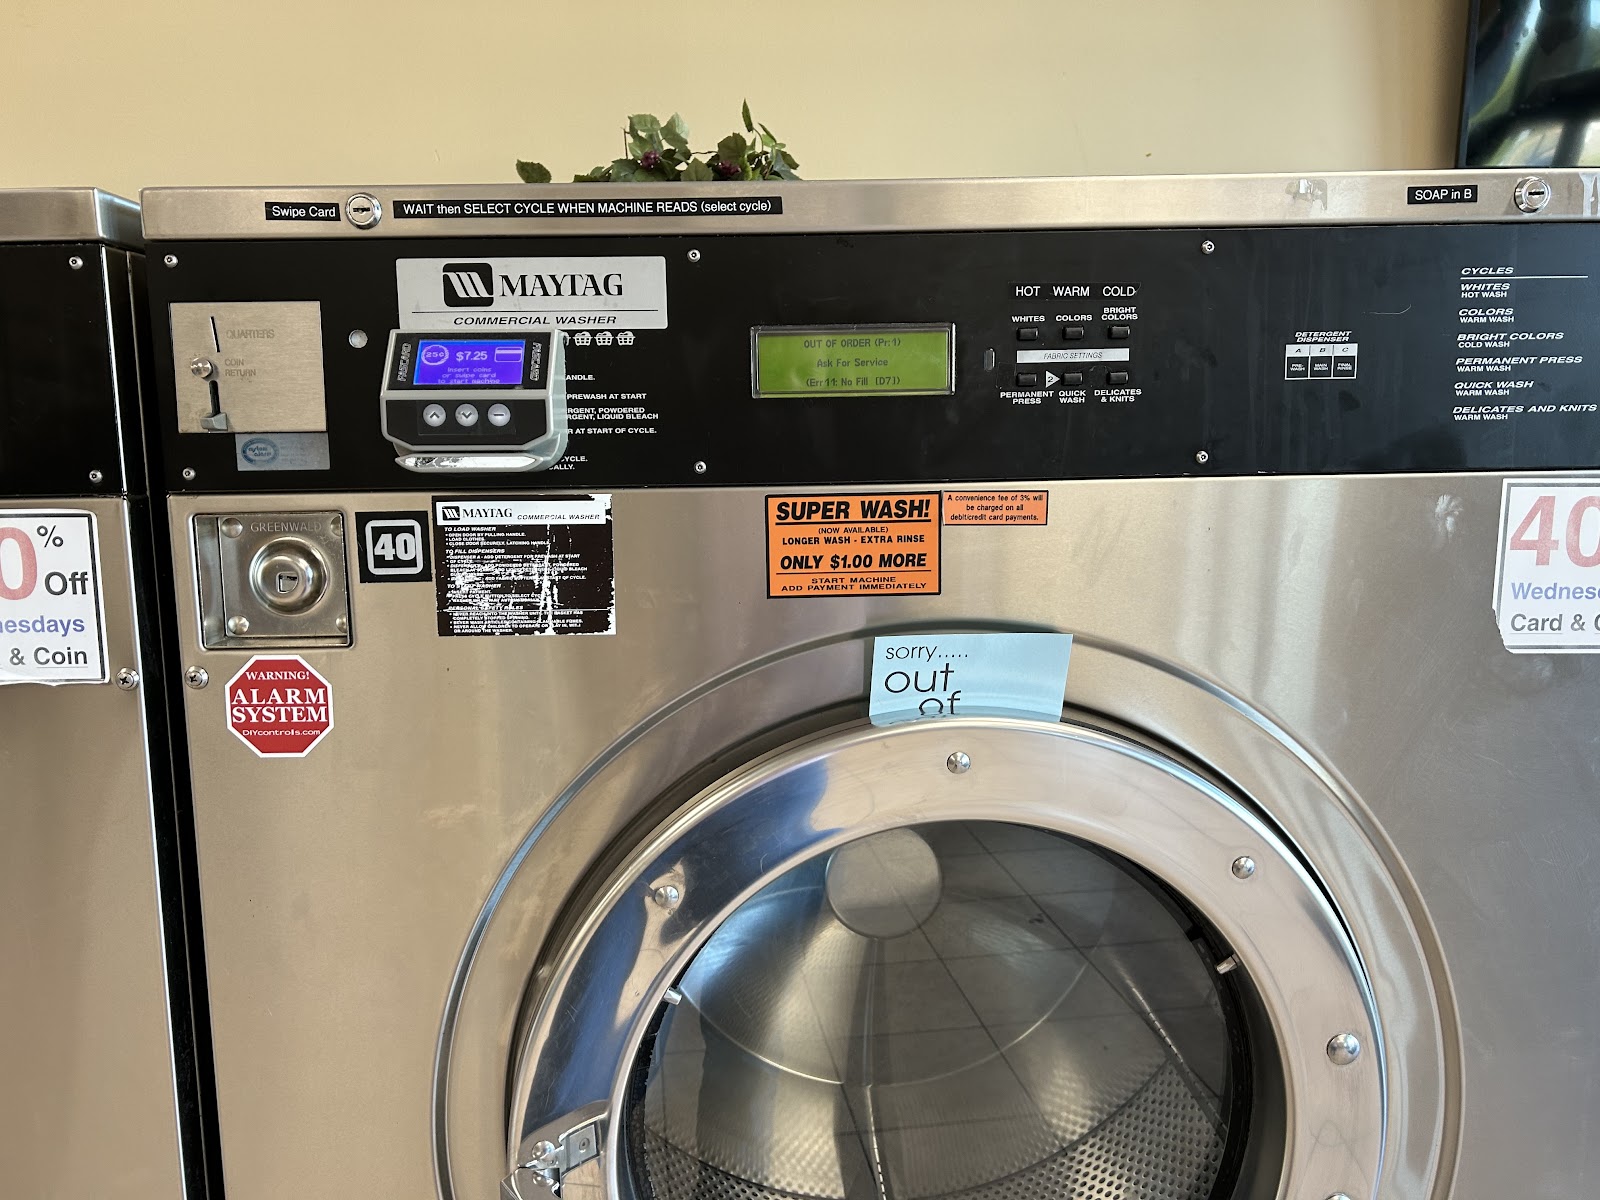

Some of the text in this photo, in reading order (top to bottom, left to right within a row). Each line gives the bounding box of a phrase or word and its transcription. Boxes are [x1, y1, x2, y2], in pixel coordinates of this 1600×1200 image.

[1414, 188, 1472, 200] SOAP in B
[403, 199, 771, 214] WAIT then SELECT CYCLE WHEN MACHINE READS (select cycle)
[272, 206, 336, 219] Swipe Card
[1461, 267, 1514, 275] CYCLES
[499, 273, 623, 298] MAYTAG
[1015, 285, 1135, 297] HOT WARM COLD
[1460, 283, 1510, 291] WHITES
[1458, 308, 1514, 316] COLORS
[453, 315, 617, 326] COMMERCIAL WASHER
[1055, 314, 1092, 322] COLORS
[226, 329, 275, 339] QUARTERS
[1457, 332, 1564, 341] BRIGHT COLORS
[804, 340, 822, 348] OUT
[826, 339, 837, 348] OF
[841, 339, 871, 347] ORDER
[1484, 340, 1510, 348] WASH
[456, 351, 488, 362] $7.25
[1455, 355, 1583, 365] PERMANENT PRESS
[817, 358, 889, 367] Ask For Service
[225, 369, 256, 377] RETURN
[841, 377, 852, 386] No
[856, 377, 868, 386] Fill
[1454, 380, 1534, 389] QUICK WASH
[1452, 404, 1597, 414] DELICATES AND KNITS
[462, 508, 512, 518] MAYTAG
[776, 499, 931, 521] SUPER WASH!
[977, 504, 1003, 512] charged
[1006, 513, 1039, 521] payments.
[251, 522, 322, 533] GREENWALD
[843, 526, 889, 534] AVAILABLE)
[1509, 496, 1600, 567] 40
[782, 534, 925, 545] LONGER WASH EXTRA RINSE
[374, 532, 416, 561] 40
[780, 553, 927, 570] ONLY $1.00 MORE
[44, 571, 88, 596] Off
[859, 582, 926, 590] IMMEDIATELY
[0, 615, 85, 636] esdays
[1511, 613, 1563, 631] Card
[1570, 614, 1586, 631] &
[9, 647, 88, 665] & Coin
[886, 644, 969, 663] sorry.....
[246, 671, 310, 681] WARNING!
[884, 662, 955, 693] out
[232, 688, 326, 705] ALARM
[232, 706, 328, 723] SYSTEM
